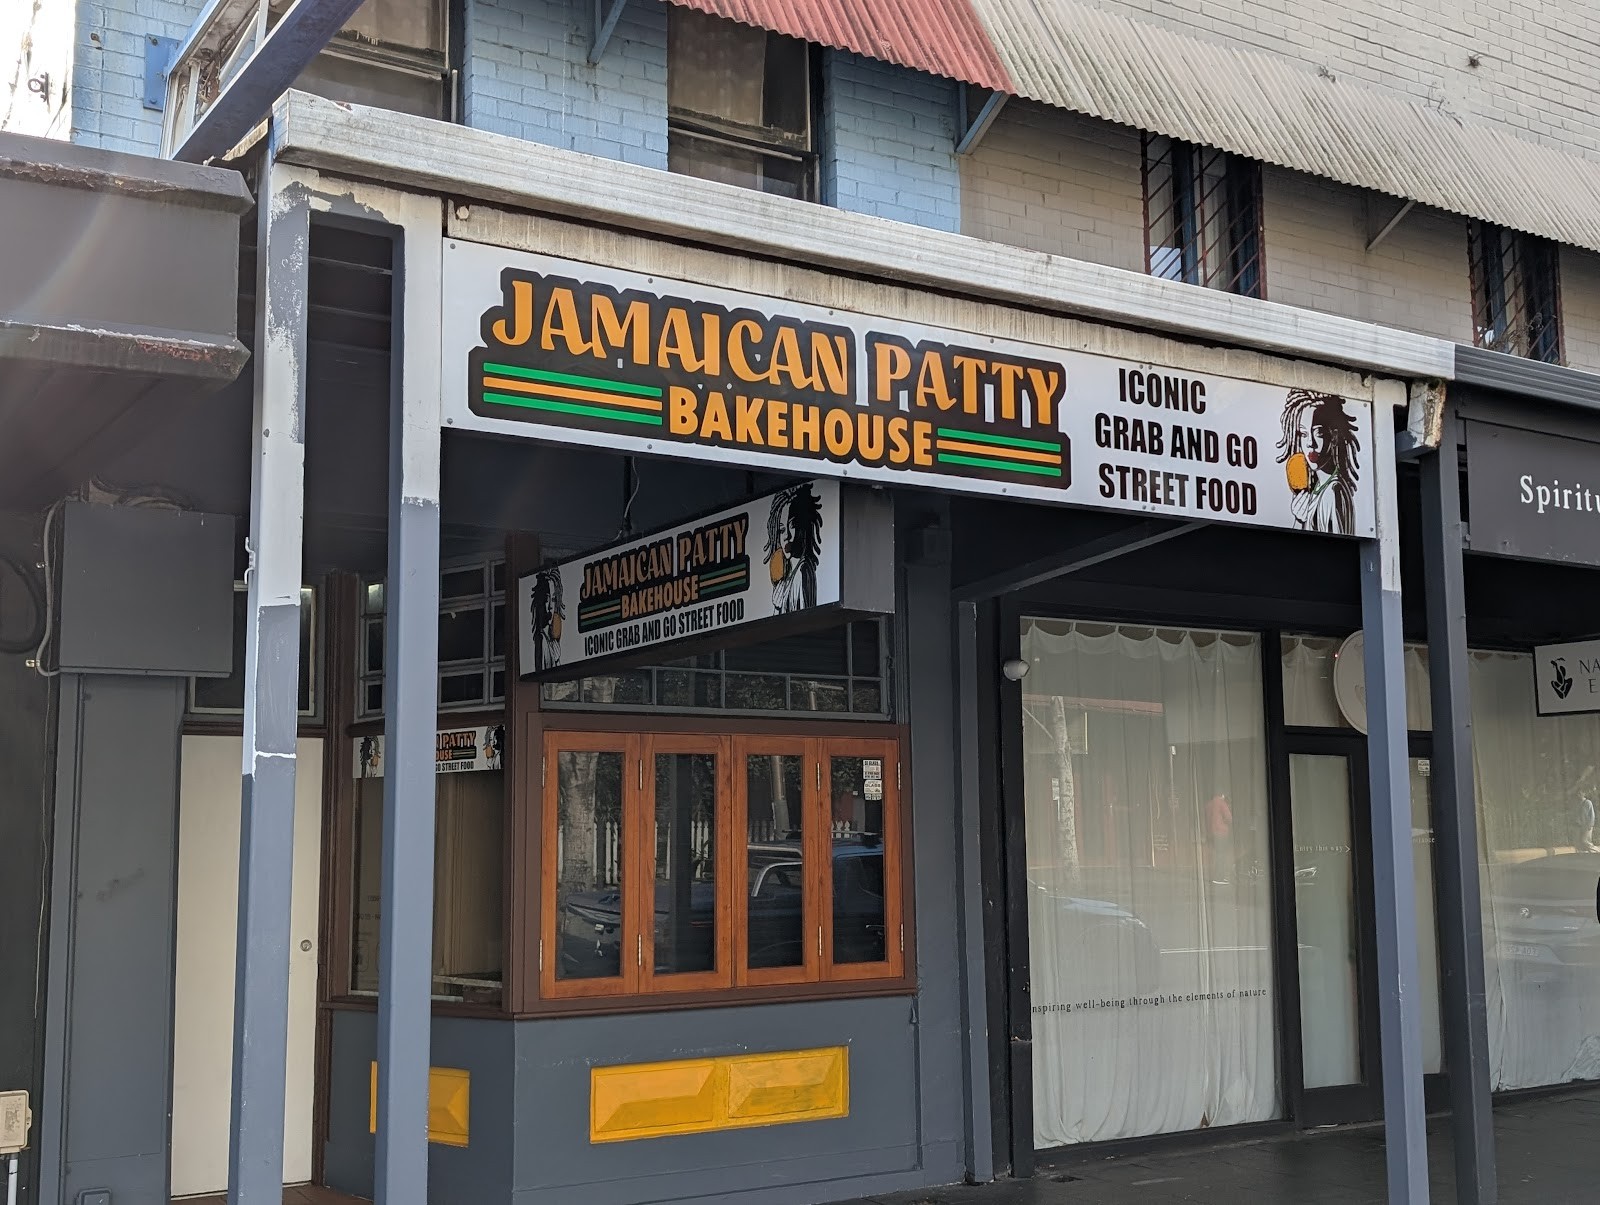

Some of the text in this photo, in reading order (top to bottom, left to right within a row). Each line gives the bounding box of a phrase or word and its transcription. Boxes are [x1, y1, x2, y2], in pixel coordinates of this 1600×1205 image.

[492, 279, 1060, 425] JAMAICAN PATTY
[1118, 368, 1206, 414] ICONIC
[668, 386, 933, 467] BAKEHOUSE
[1094, 412, 1258, 470] GRAB AND GO
[1098, 463, 1258, 516] STREET FOOD
[581, 518, 747, 599] JAMAICAN PATTY
[621, 575, 699, 619] BAKEHOUSE
[584, 598, 745, 657] ICONIC GRAB AND GO STREET FOOD
[442, 732, 475, 748] PATTY
[442, 762, 459, 772] STREET
[461, 761, 474, 770] FOOD
[1032, 988, 1267, 1015] nspiring well-being through the elements of nature
